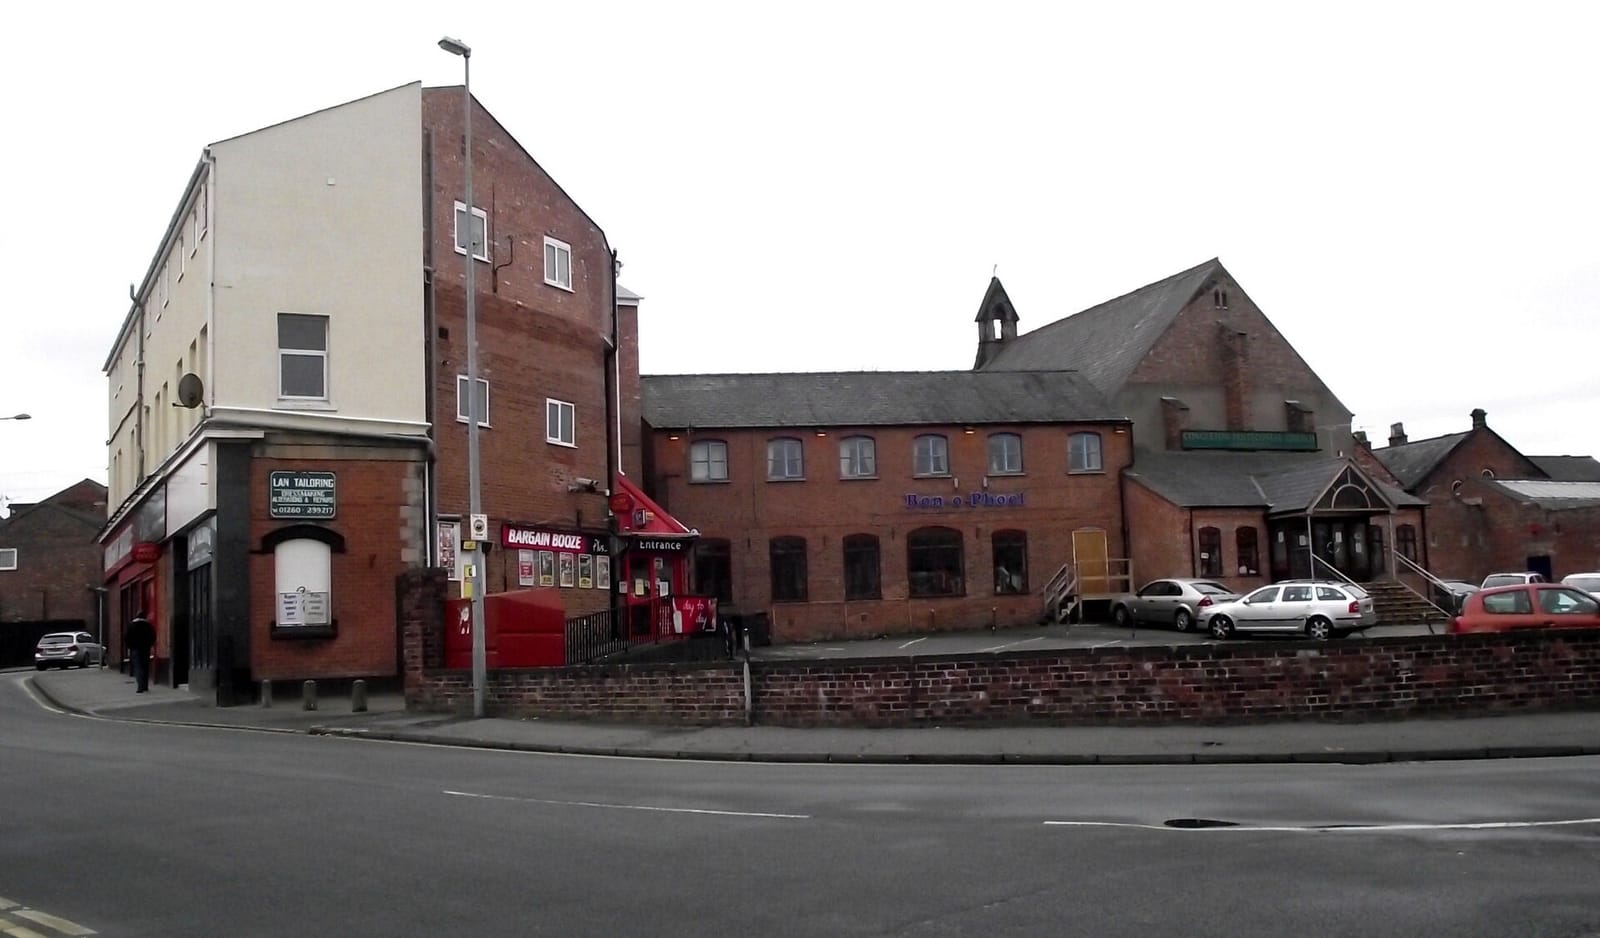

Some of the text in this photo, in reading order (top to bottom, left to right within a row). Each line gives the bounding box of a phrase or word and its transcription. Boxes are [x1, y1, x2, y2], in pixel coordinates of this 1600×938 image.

[273, 478, 334, 488] LAN TAILORING
[508, 528, 550, 547] BARGAIN
[552, 533, 581, 549] BOOZE
[640, 540, 682, 550] Entrance
[697, 600, 704, 611] to
